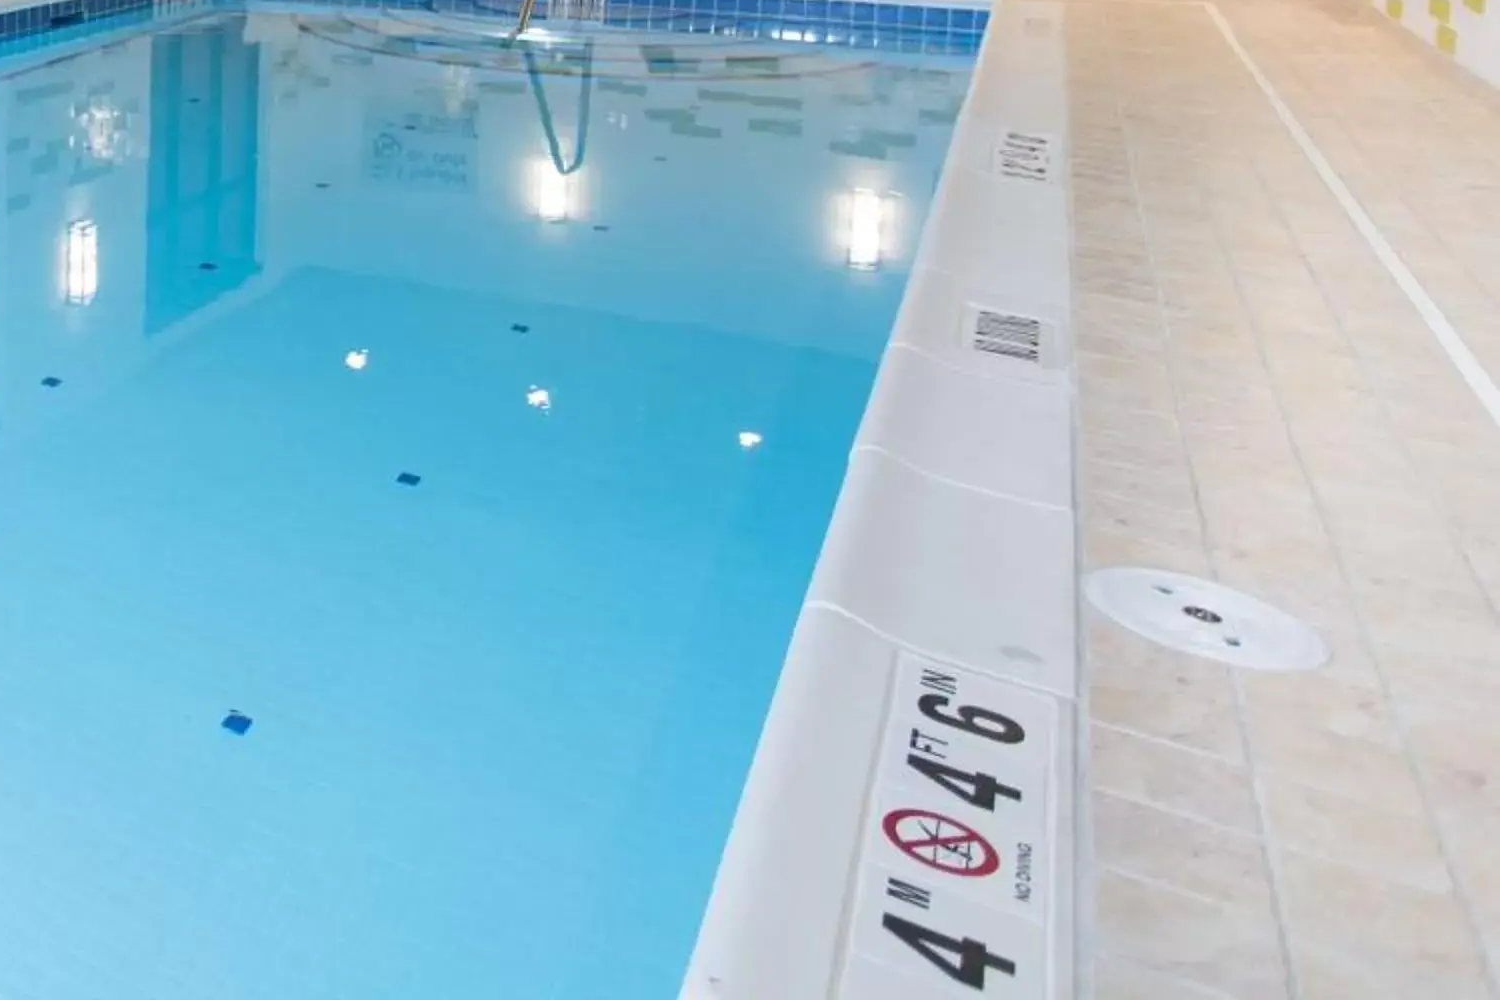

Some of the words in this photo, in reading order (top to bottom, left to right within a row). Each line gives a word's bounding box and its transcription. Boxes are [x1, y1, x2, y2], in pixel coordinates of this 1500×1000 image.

[919, 667, 957, 695] IN
[916, 693, 1026, 745] 6
[909, 727, 949, 760] FT
[906, 752, 1023, 813] 4
[885, 876, 932, 910] M
[881, 910, 1017, 992] 4
